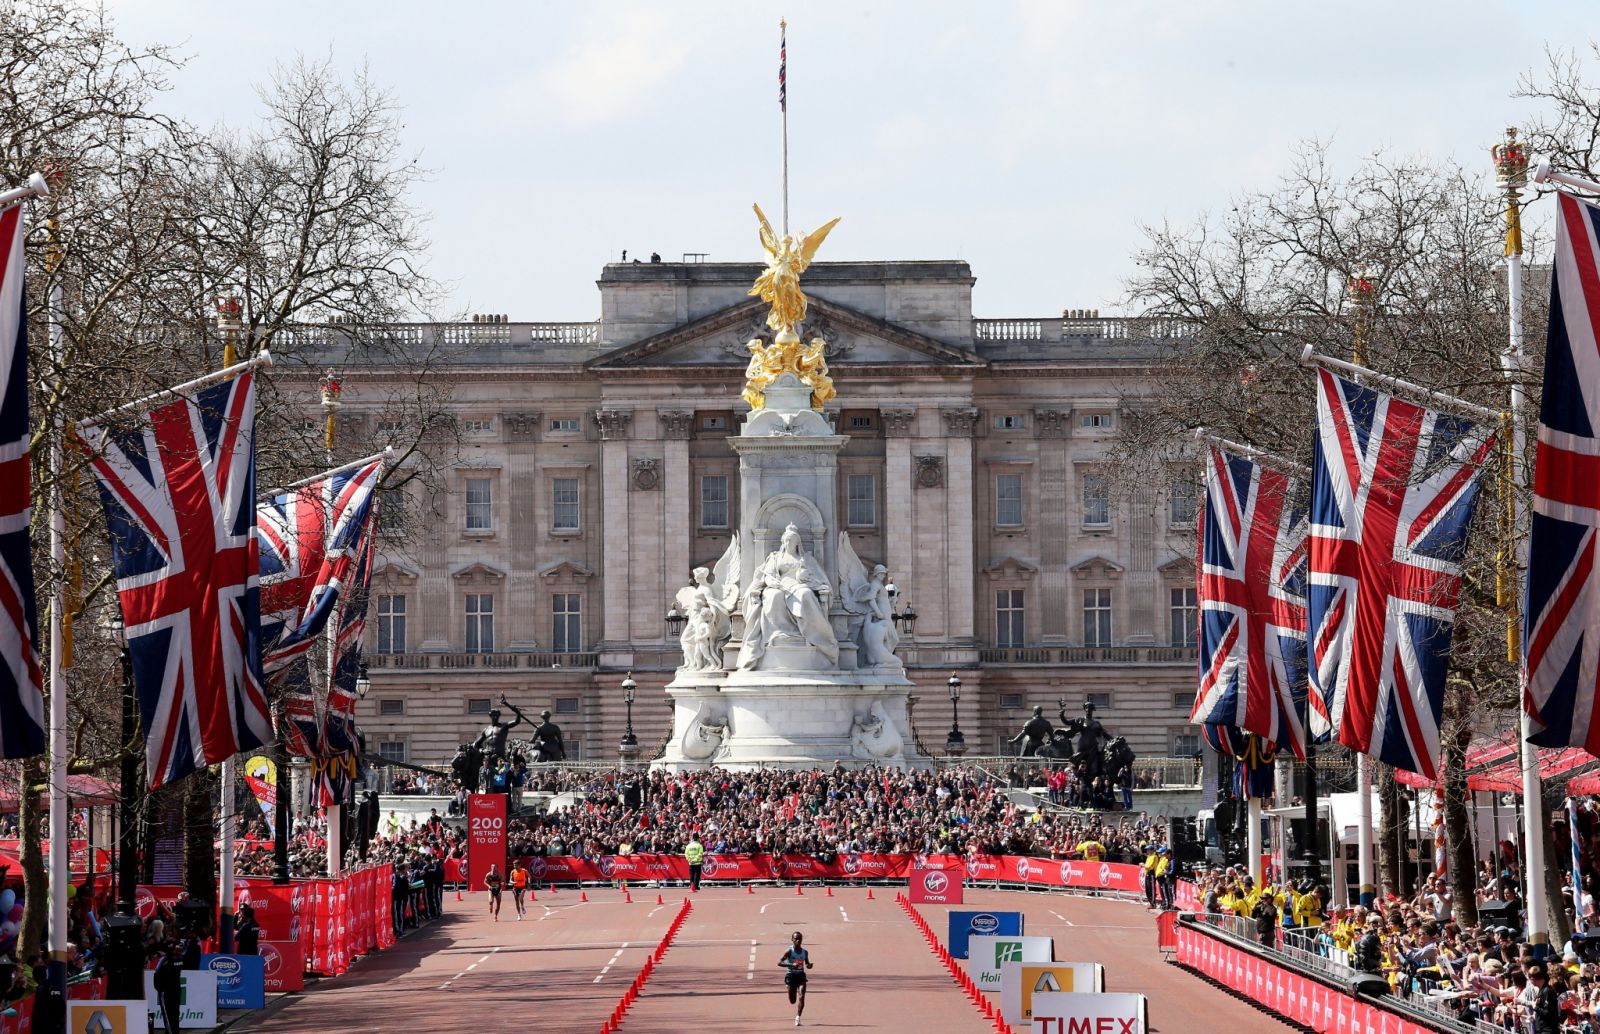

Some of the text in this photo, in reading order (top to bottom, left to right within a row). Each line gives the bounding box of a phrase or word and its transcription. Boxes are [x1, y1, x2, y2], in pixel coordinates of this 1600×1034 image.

[472, 817, 503, 829] 200
[548, 864, 569, 873] money
[616, 862, 637, 871] money
[648, 861, 670, 870] money
[718, 861, 740, 870] money
[788, 862, 811, 870] money
[862, 861, 886, 869] money
[980, 862, 996, 870] money
[1029, 866, 1043, 874] money
[926, 874, 946, 891] Virgin
[252, 899, 268, 910] money
[226, 976, 240, 985] Life
[980, 971, 1000, 982] Holi
[264, 978, 283, 988] oney
[185, 1008, 204, 1020] Inn
[1033, 1016, 1136, 1034] TIMEX
